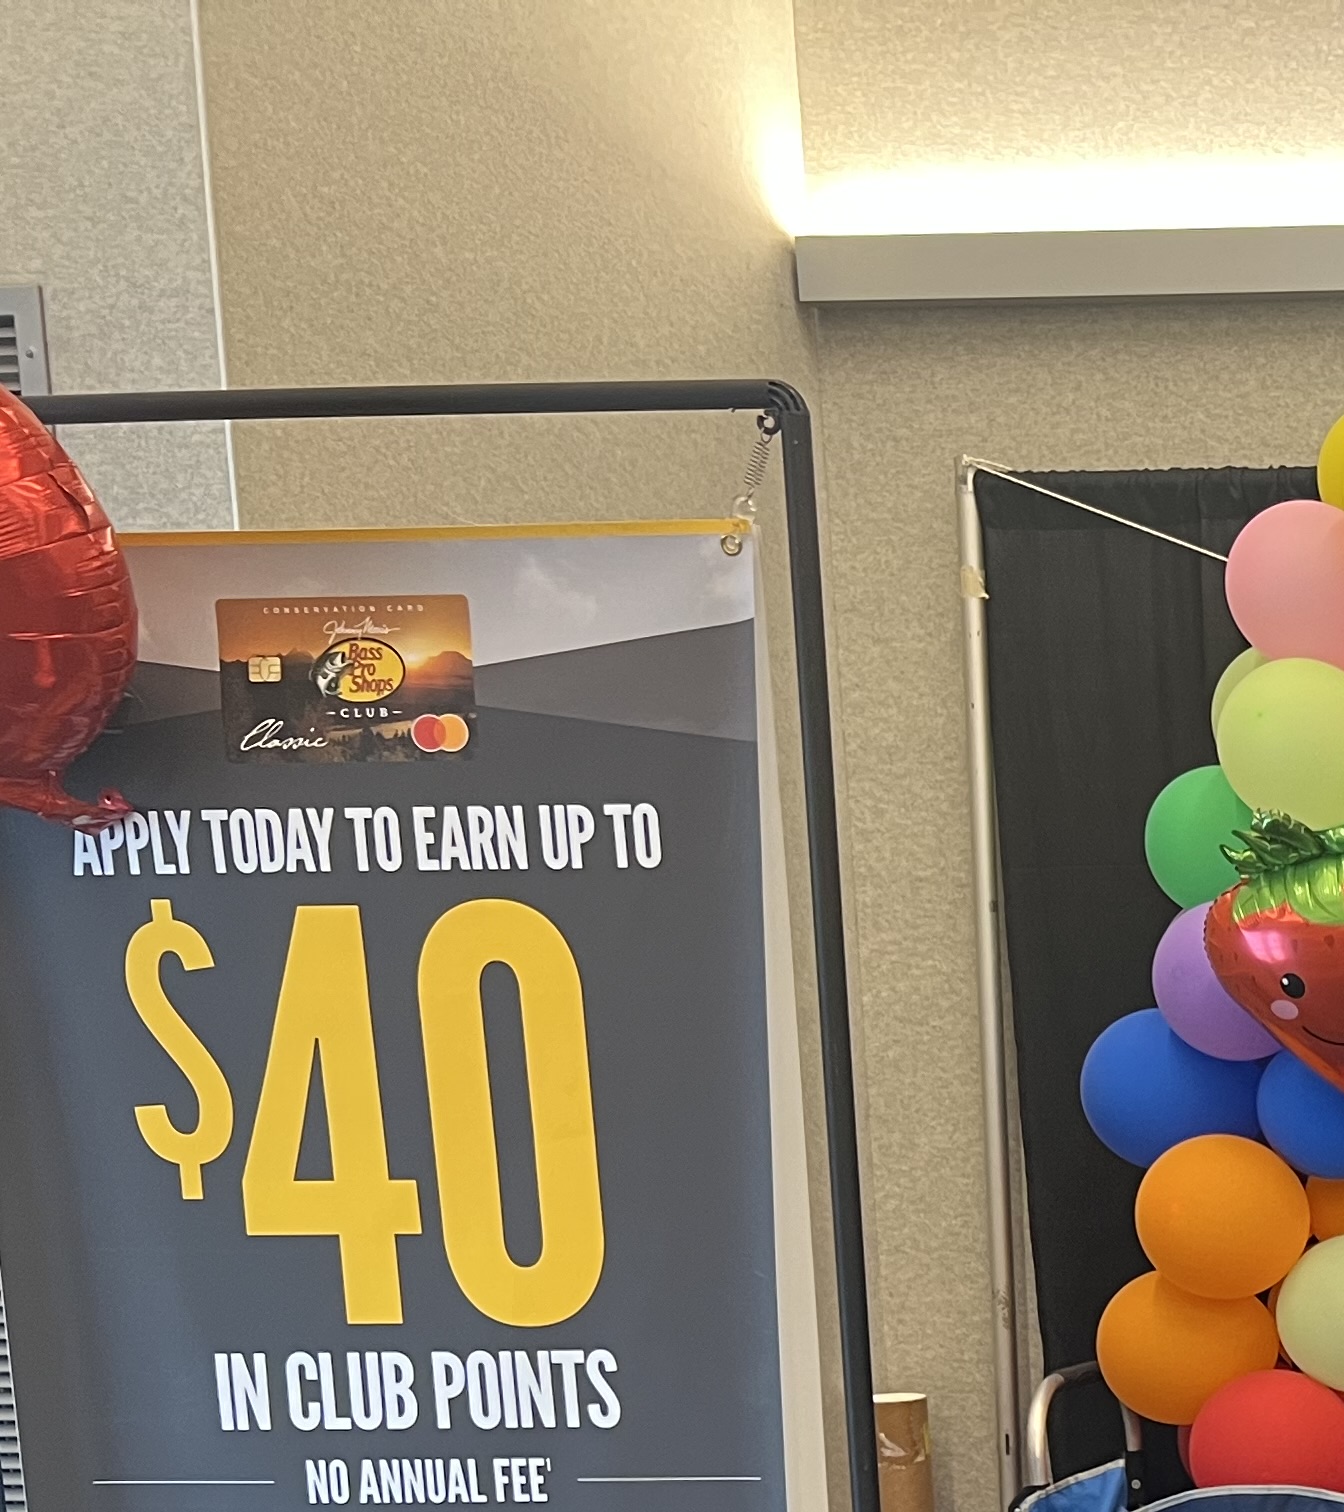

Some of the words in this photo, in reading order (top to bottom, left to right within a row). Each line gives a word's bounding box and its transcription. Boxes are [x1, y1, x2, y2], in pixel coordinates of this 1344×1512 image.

[263, 604, 376, 615] CONSERVATION
[386, 603, 424, 612] CARD
[349, 643, 383, 661] Bass
[351, 660, 375, 677] Pro
[350, 675, 394, 697] Shops
[339, 707, 390, 719] CLUB
[239, 718, 329, 752] Classic
[72, 808, 192, 877] APPLY
[200, 807, 333, 874] TODAY
[343, 806, 402, 873] TO
[412, 805, 528, 872] EARN
[538, 804, 596, 871] UP
[603, 803, 662, 869] TO
[124, 898, 606, 1328] $40
[214, 1351, 273, 1432] IN
[284, 1350, 418, 1432] CLUB
[432, 1348, 622, 1430] POINTS
[304, 1458, 350, 1505] NO
[358, 1457, 488, 1504] ANNUAL
